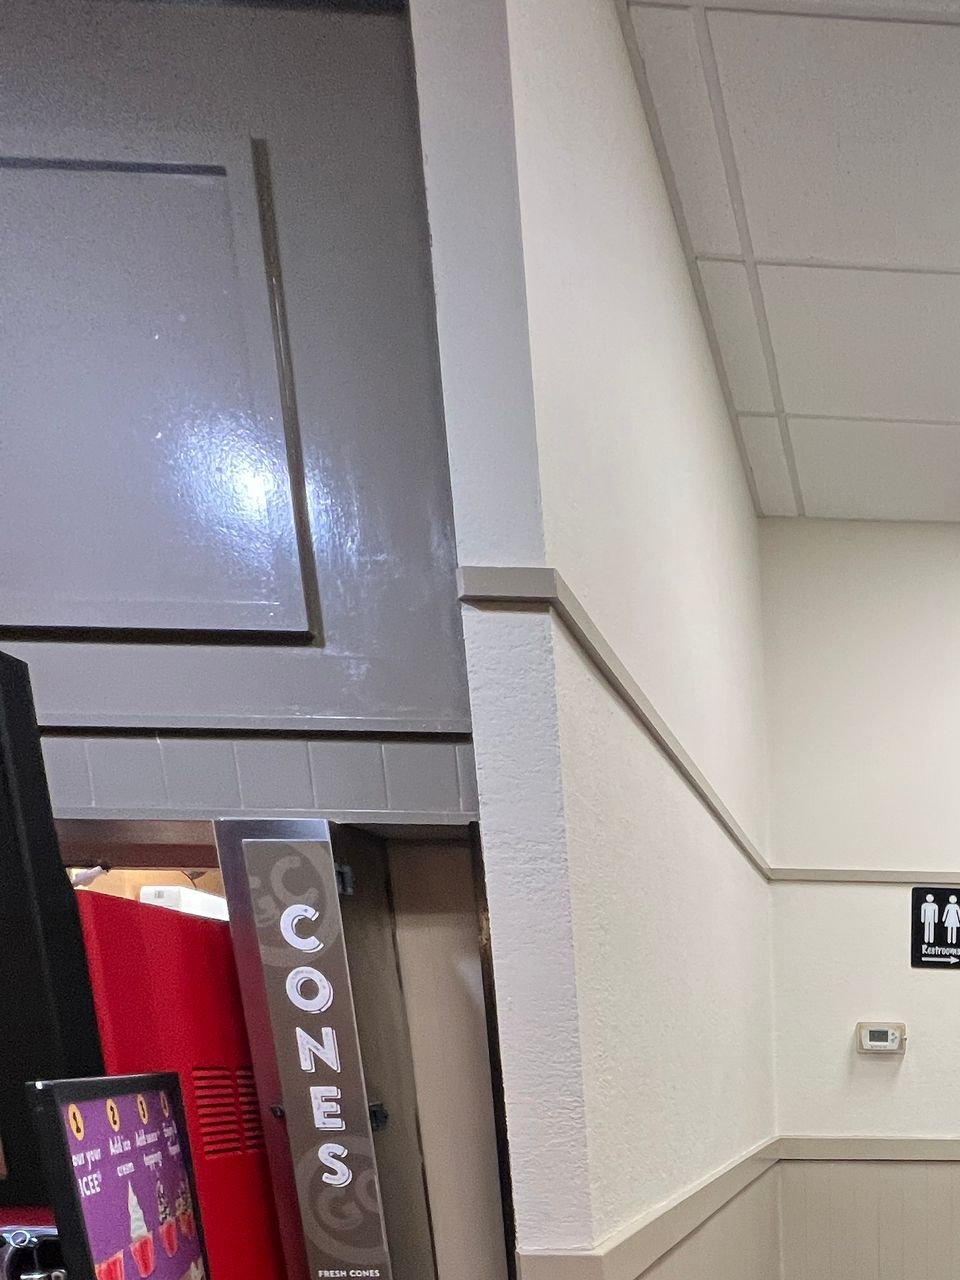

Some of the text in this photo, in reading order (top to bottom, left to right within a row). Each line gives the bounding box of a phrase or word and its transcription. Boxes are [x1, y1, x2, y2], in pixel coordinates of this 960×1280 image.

[921, 944, 960, 956] Restrooms
[280, 904, 352, 1188] CONES
[109, 1135, 122, 1156] Add
[86, 1148, 101, 1170] your
[318, 1269, 380, 1278] FRESH CONES
